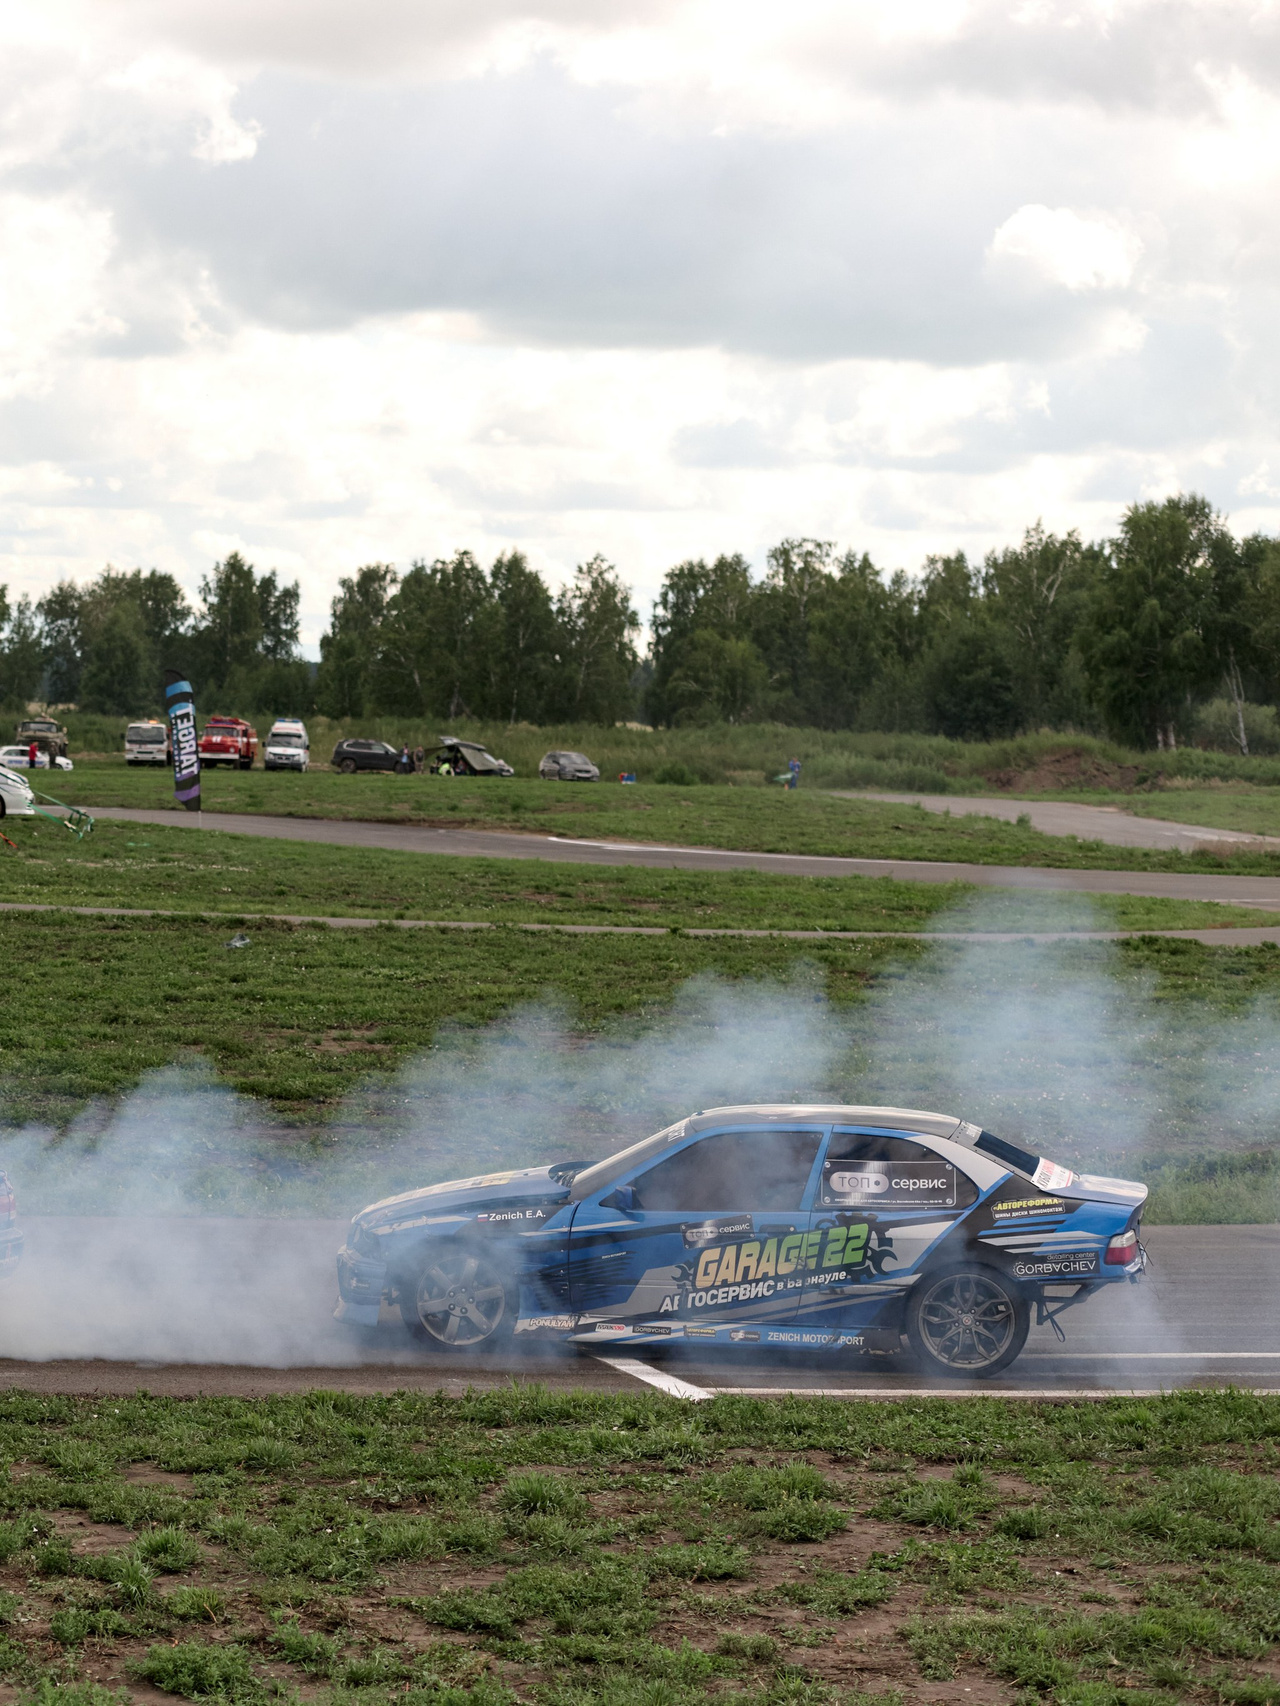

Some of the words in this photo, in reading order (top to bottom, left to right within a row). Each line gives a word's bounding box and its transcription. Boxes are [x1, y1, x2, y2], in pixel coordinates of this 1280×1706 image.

[838, 1176, 870, 1188] ТОП
[891, 1178, 947, 1191] сервис
[489, 1211, 523, 1221] Zenich
[526, 1209, 546, 1218] E.A.
[720, 1222, 750, 1235] сервис
[695, 1229, 822, 1288] GARAGE
[822, 1223, 869, 1268] 22
[529, 1318, 575, 1328] PONULYAM
[767, 1331, 800, 1341] ZENICH
